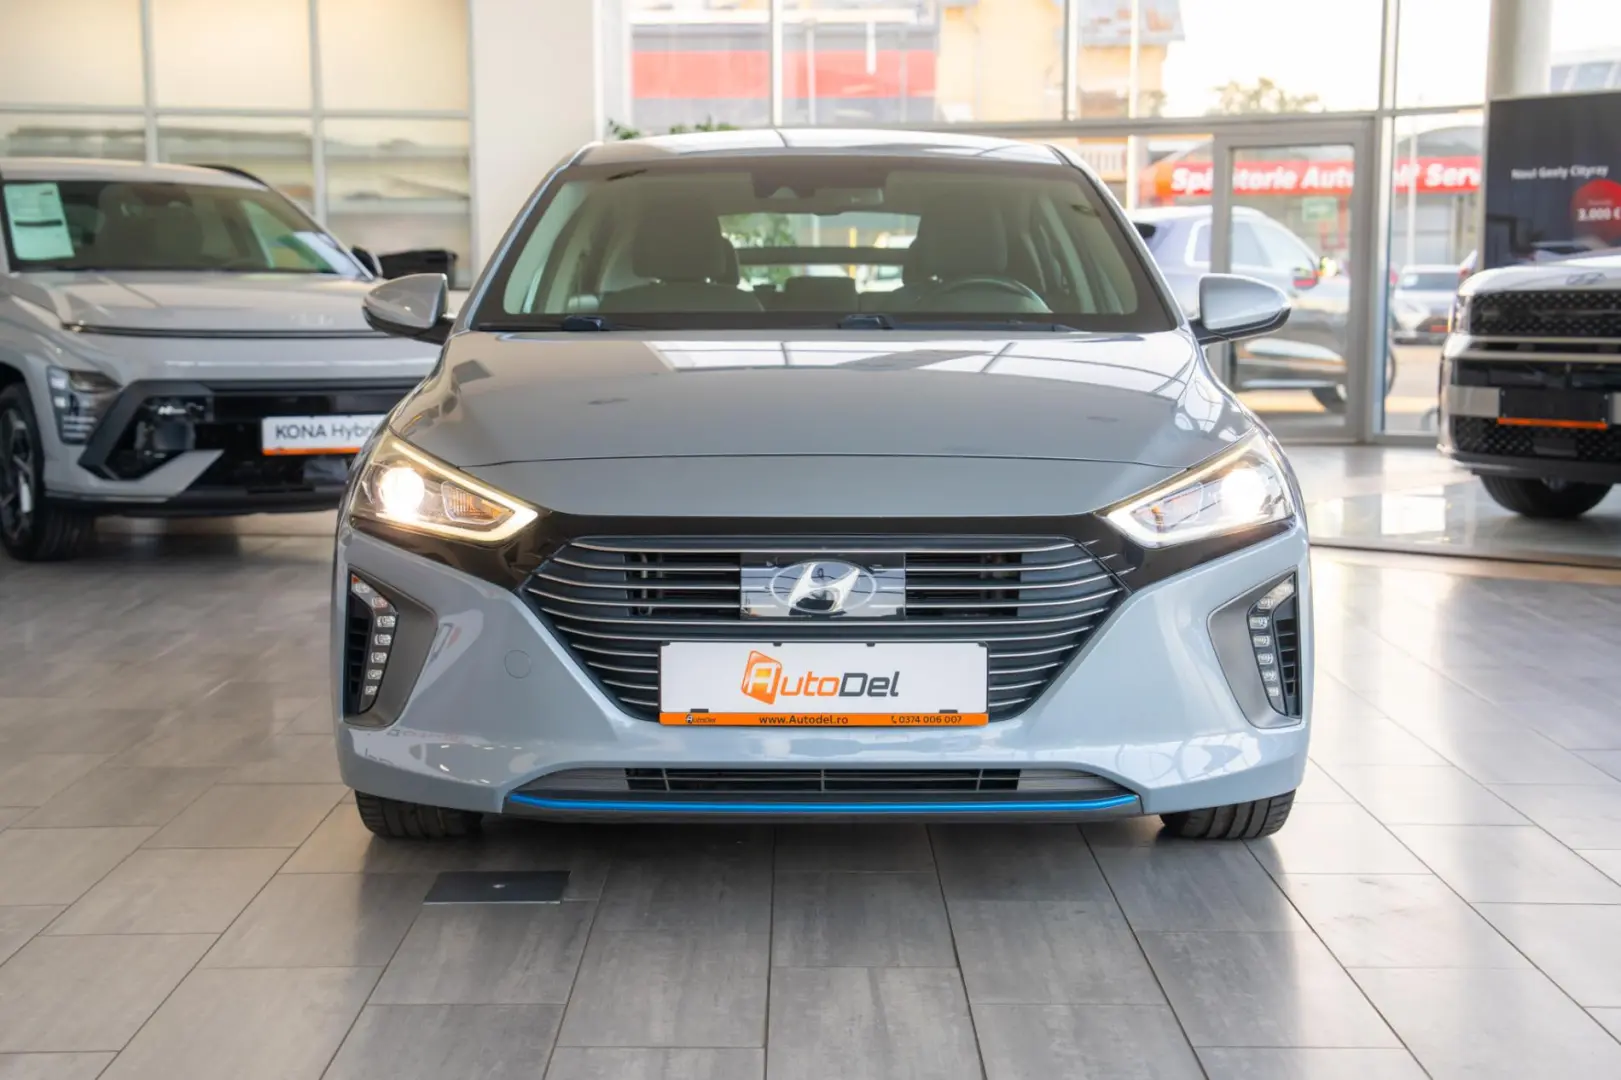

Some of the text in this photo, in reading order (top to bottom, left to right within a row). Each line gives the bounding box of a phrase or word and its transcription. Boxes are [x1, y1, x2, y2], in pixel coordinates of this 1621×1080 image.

[275, 421, 375, 441] KONA Hybr
[744, 652, 900, 704] AutoDel
[759, 714, 849, 725] www.Autodel.ro
[898, 715, 920, 724] 0374
[923, 715, 942, 724] 006
[944, 715, 962, 724] 007
